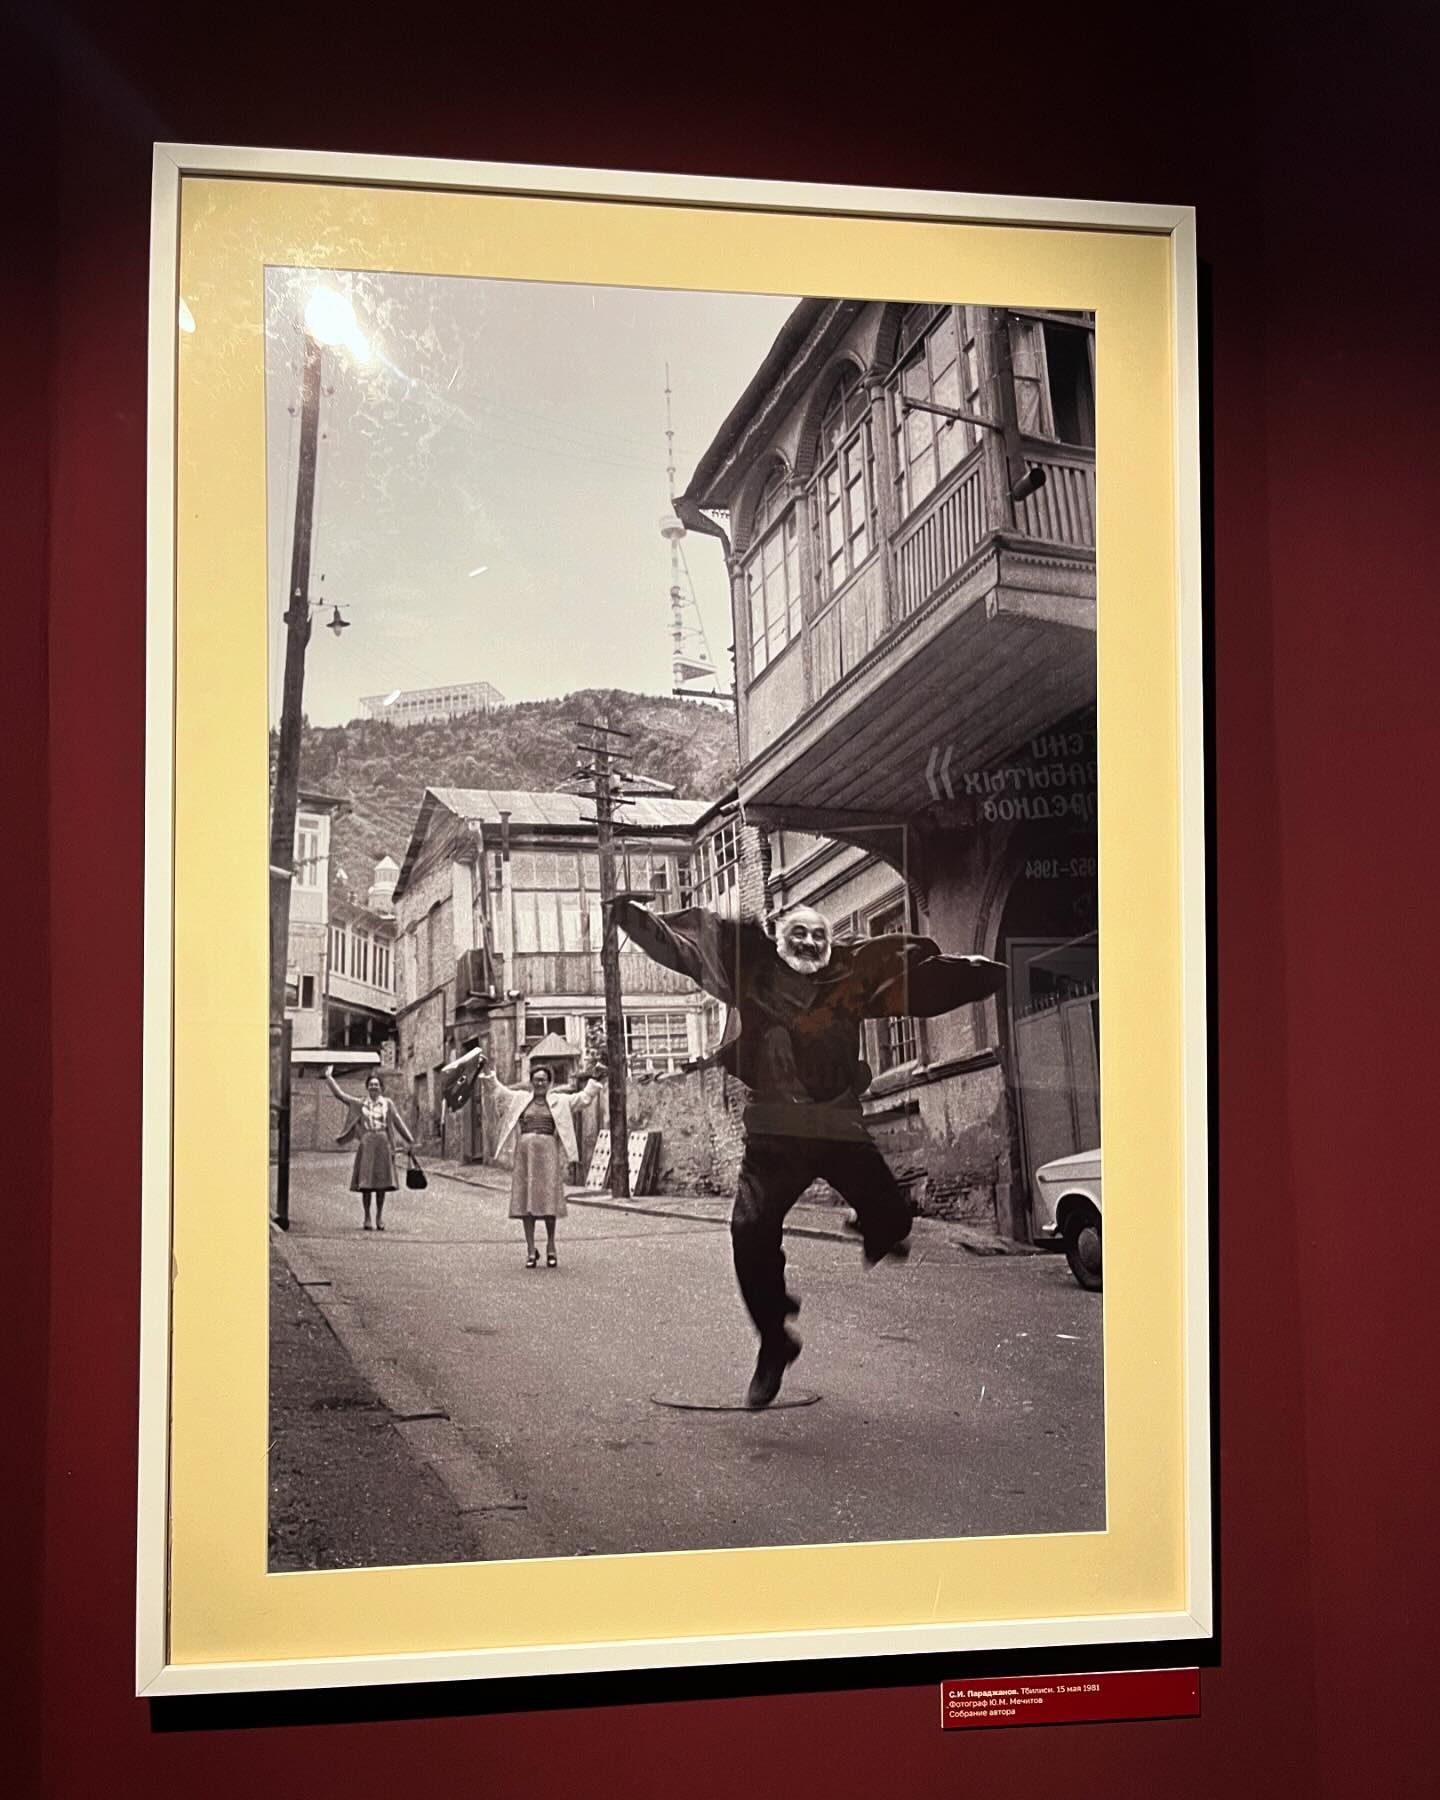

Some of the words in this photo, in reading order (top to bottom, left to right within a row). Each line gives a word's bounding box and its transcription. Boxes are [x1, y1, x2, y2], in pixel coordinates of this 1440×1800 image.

[1083, 1684, 1100, 1692] 1981
[949, 1699, 988, 1708] Фотограф
[989, 1698, 1008, 1706] Ю.М.
[1010, 1697, 1043, 1705] Мечитов
[949, 1709, 988, 1718] Собрание
[989, 1708, 1016, 1717] автора
